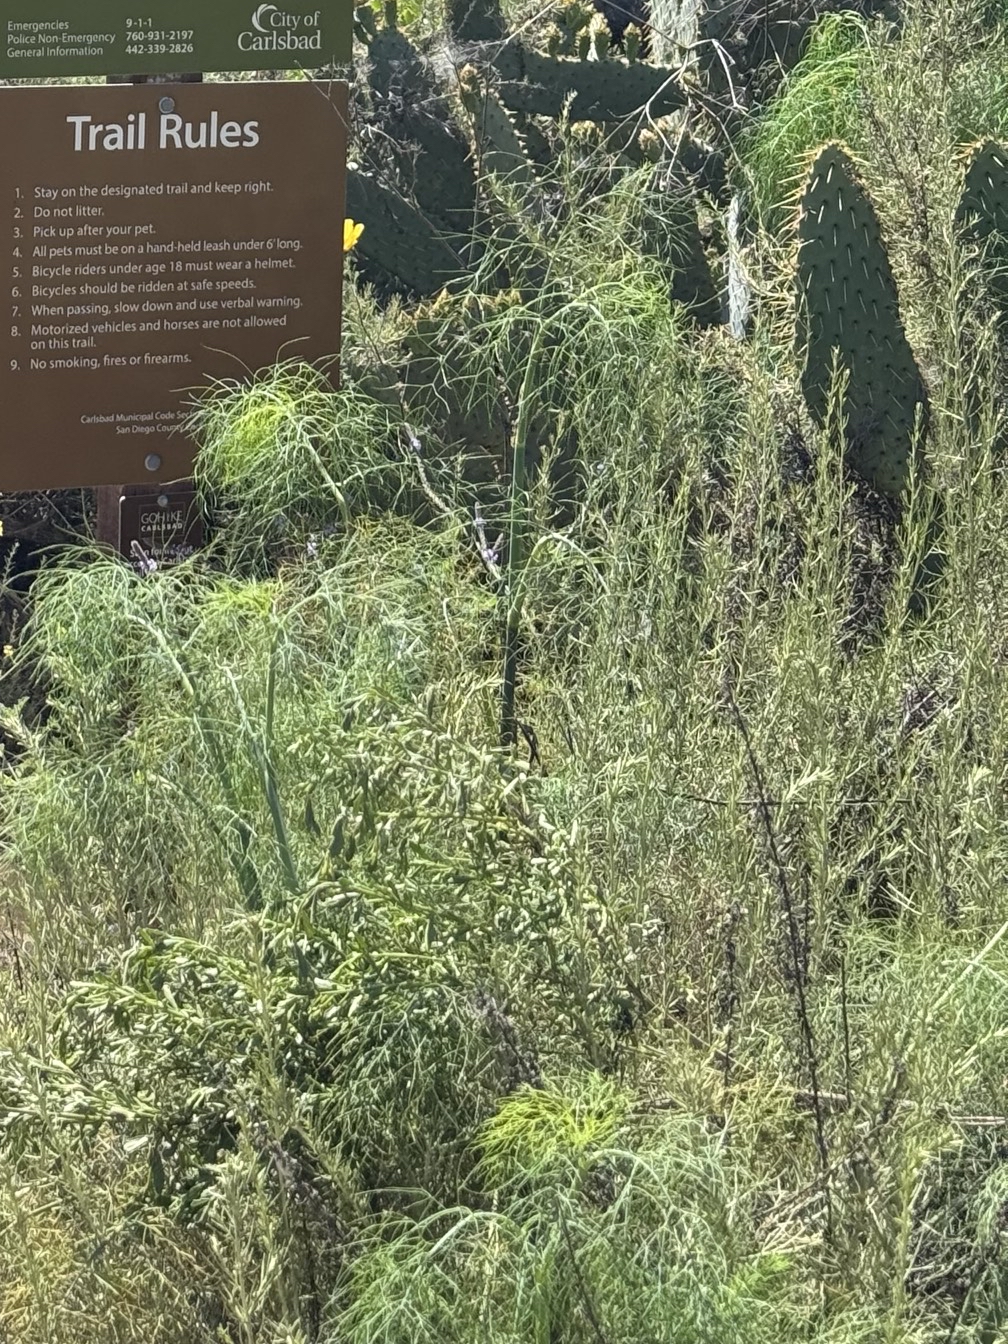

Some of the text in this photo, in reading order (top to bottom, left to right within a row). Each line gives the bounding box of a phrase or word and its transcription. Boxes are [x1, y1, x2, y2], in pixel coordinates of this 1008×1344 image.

[7, 18, 152, 32] Emergencies 9-1-1
[270, 11, 321, 31] City of
[7, 30, 194, 44] Police Non-Emergency 760-931-2197
[238, 30, 322, 51] Carlsbad
[7, 43, 194, 57] General Information 442-339-2826
[66, 111, 260, 151] Trail Rules
[15, 181, 274, 201] 1. Stay on the designated trail and keep right.
[13, 205, 105, 219] 2. Do not litter.
[13, 224, 156, 239] 3. Pick up after your pet.
[12, 247, 23, 258] 4.
[33, 245, 46, 257] All
[49, 246, 72, 259] pets
[75, 245, 102, 256] must
[104, 243, 119, 254] be
[121, 245, 135, 254] on
[137, 244, 144, 253] a
[147, 240, 201, 253] hand-held
[203, 239, 231, 252] leash
[233, 239, 264, 251] under
[12, 258, 296, 278] 5. Bicycle riders under age 18 must wear a helmet.
[12, 278, 256, 299] 6. Bicycles should be ridden at safe speeds.
[12, 296, 303, 317] 7. When passing, slow down and use verbal warning.
[11, 315, 287, 337] 8. Motorized vehicles and horses are not allowed
[30, 336, 97, 350] on this trail.
[10, 353, 192, 371] 9. No smoking, fires or firearms.
[80, 414, 115, 424] Carlsbad
[116, 412, 154, 423] Municipal
[155, 411, 175, 420] Code
[116, 425, 131, 435] San
[132, 424, 156, 435] Diego
